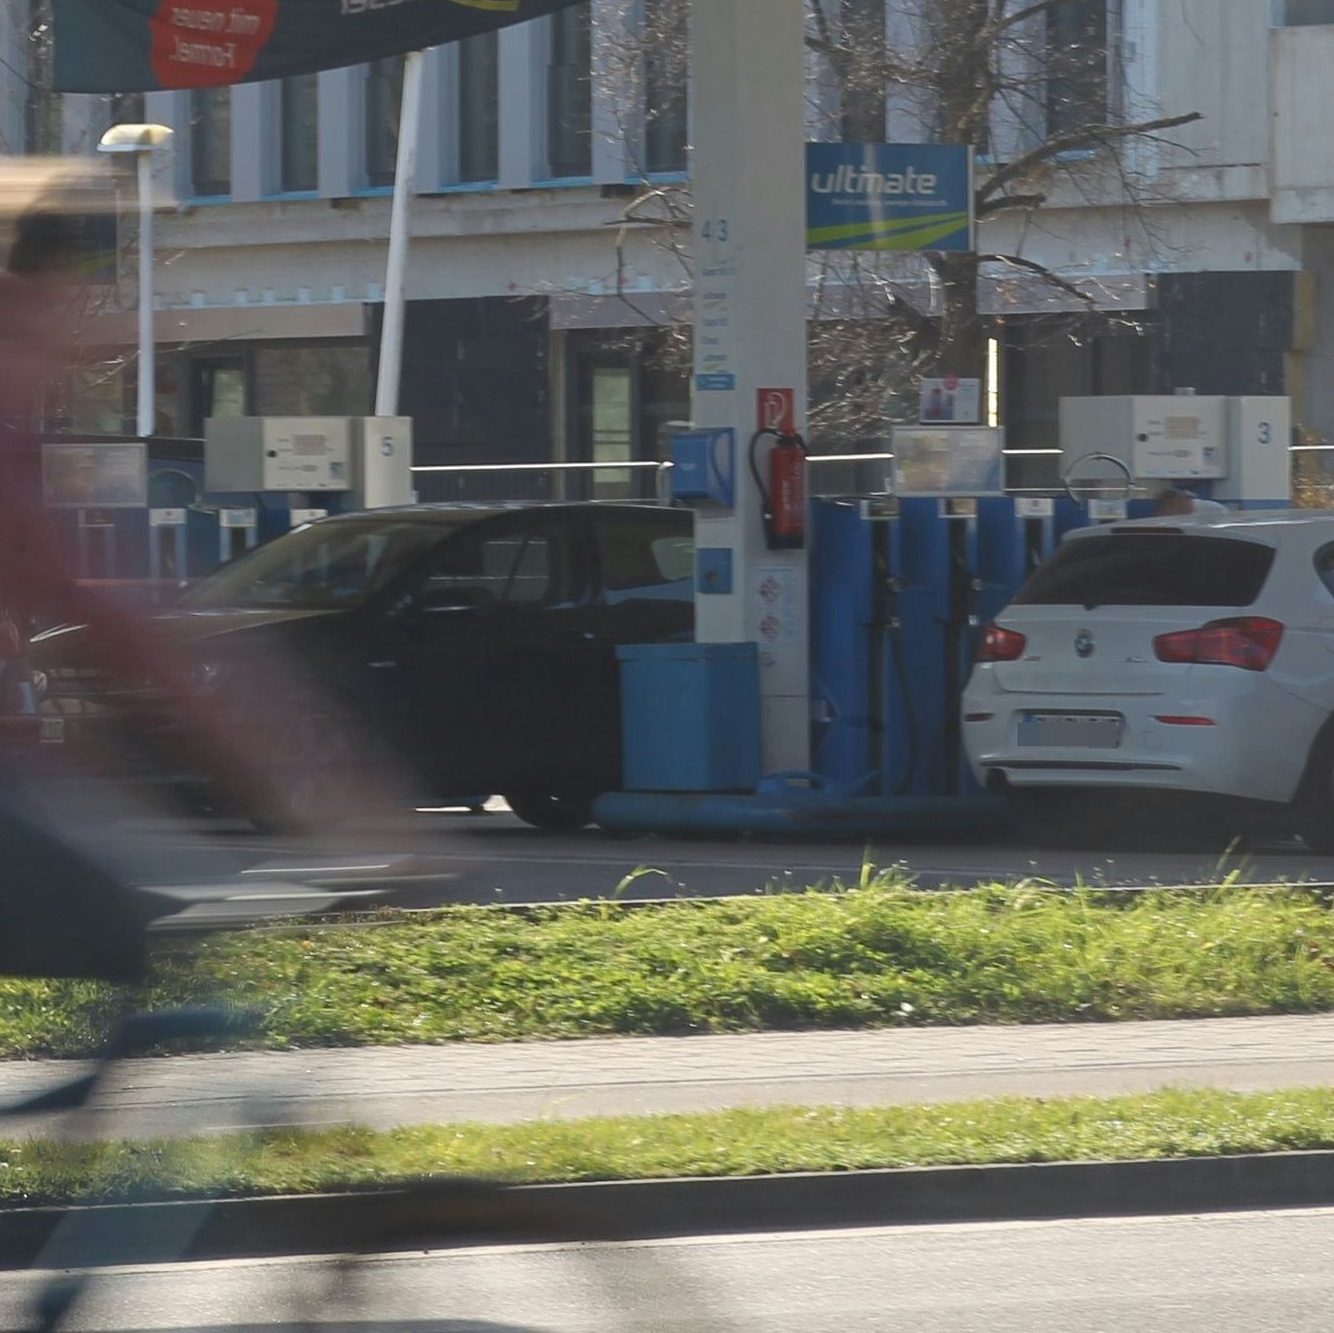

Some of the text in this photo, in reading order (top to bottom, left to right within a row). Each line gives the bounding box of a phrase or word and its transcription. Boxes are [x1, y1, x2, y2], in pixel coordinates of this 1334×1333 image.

[810, 164, 939, 195] ultimate
[1257, 422, 1271, 445] 3
[380, 436, 395, 458] 5
